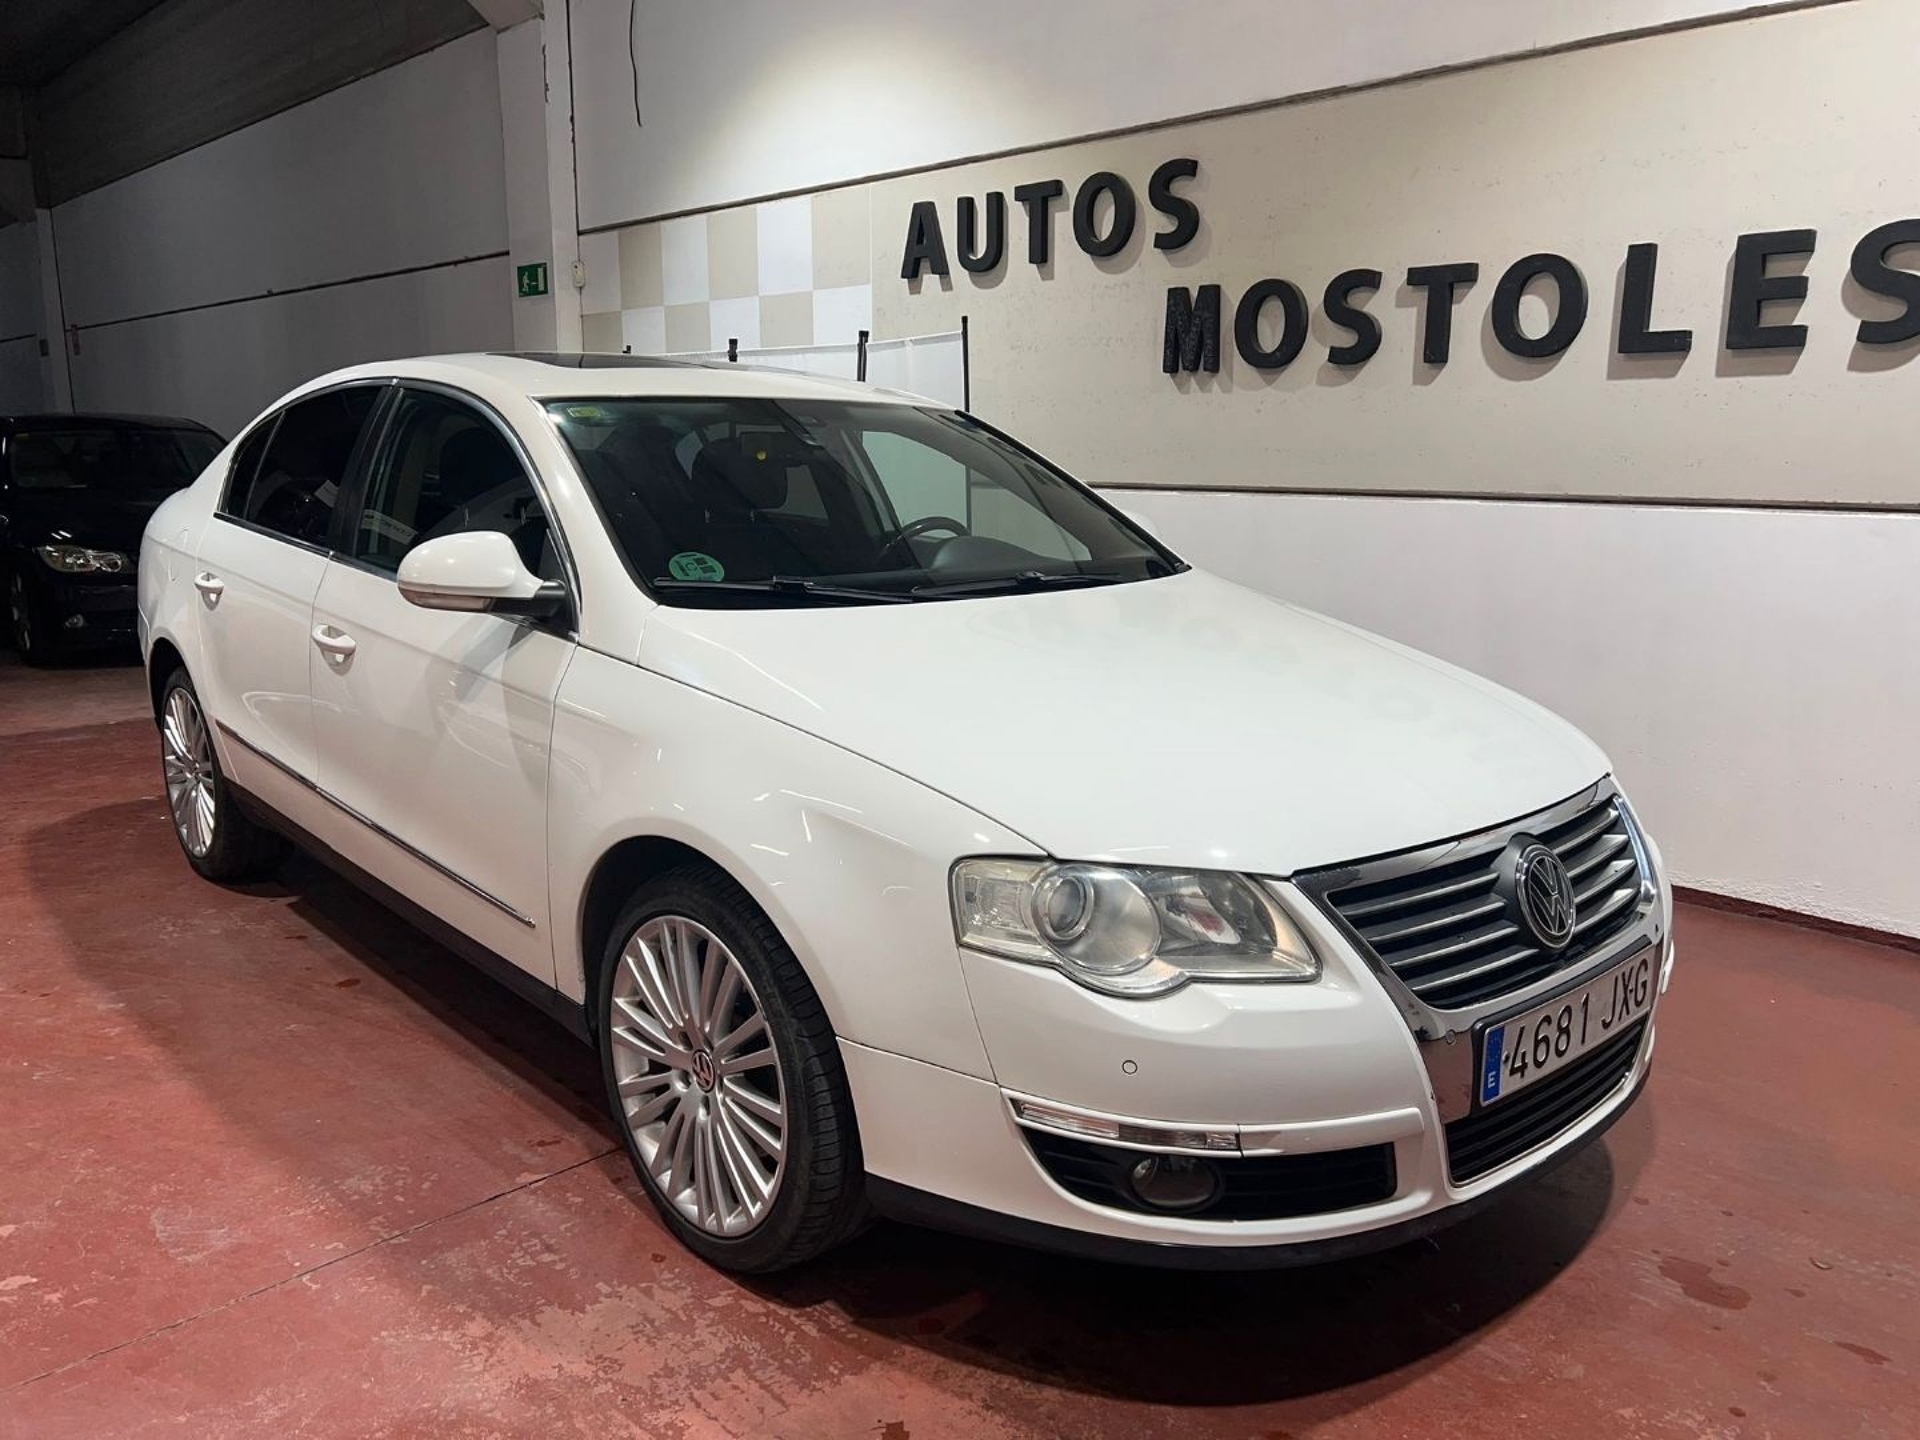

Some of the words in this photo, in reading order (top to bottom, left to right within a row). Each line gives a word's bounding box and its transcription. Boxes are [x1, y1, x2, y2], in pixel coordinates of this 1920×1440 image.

[900, 158, 1200, 279] AUTOS
[1163, 218, 1920, 374] MOSTOLES
[1524, 850, 1574, 940] VW
[1486, 1070, 1498, 1089] E
[1508, 992, 1591, 1079] 4681
[1600, 957, 1650, 1031] JXG
